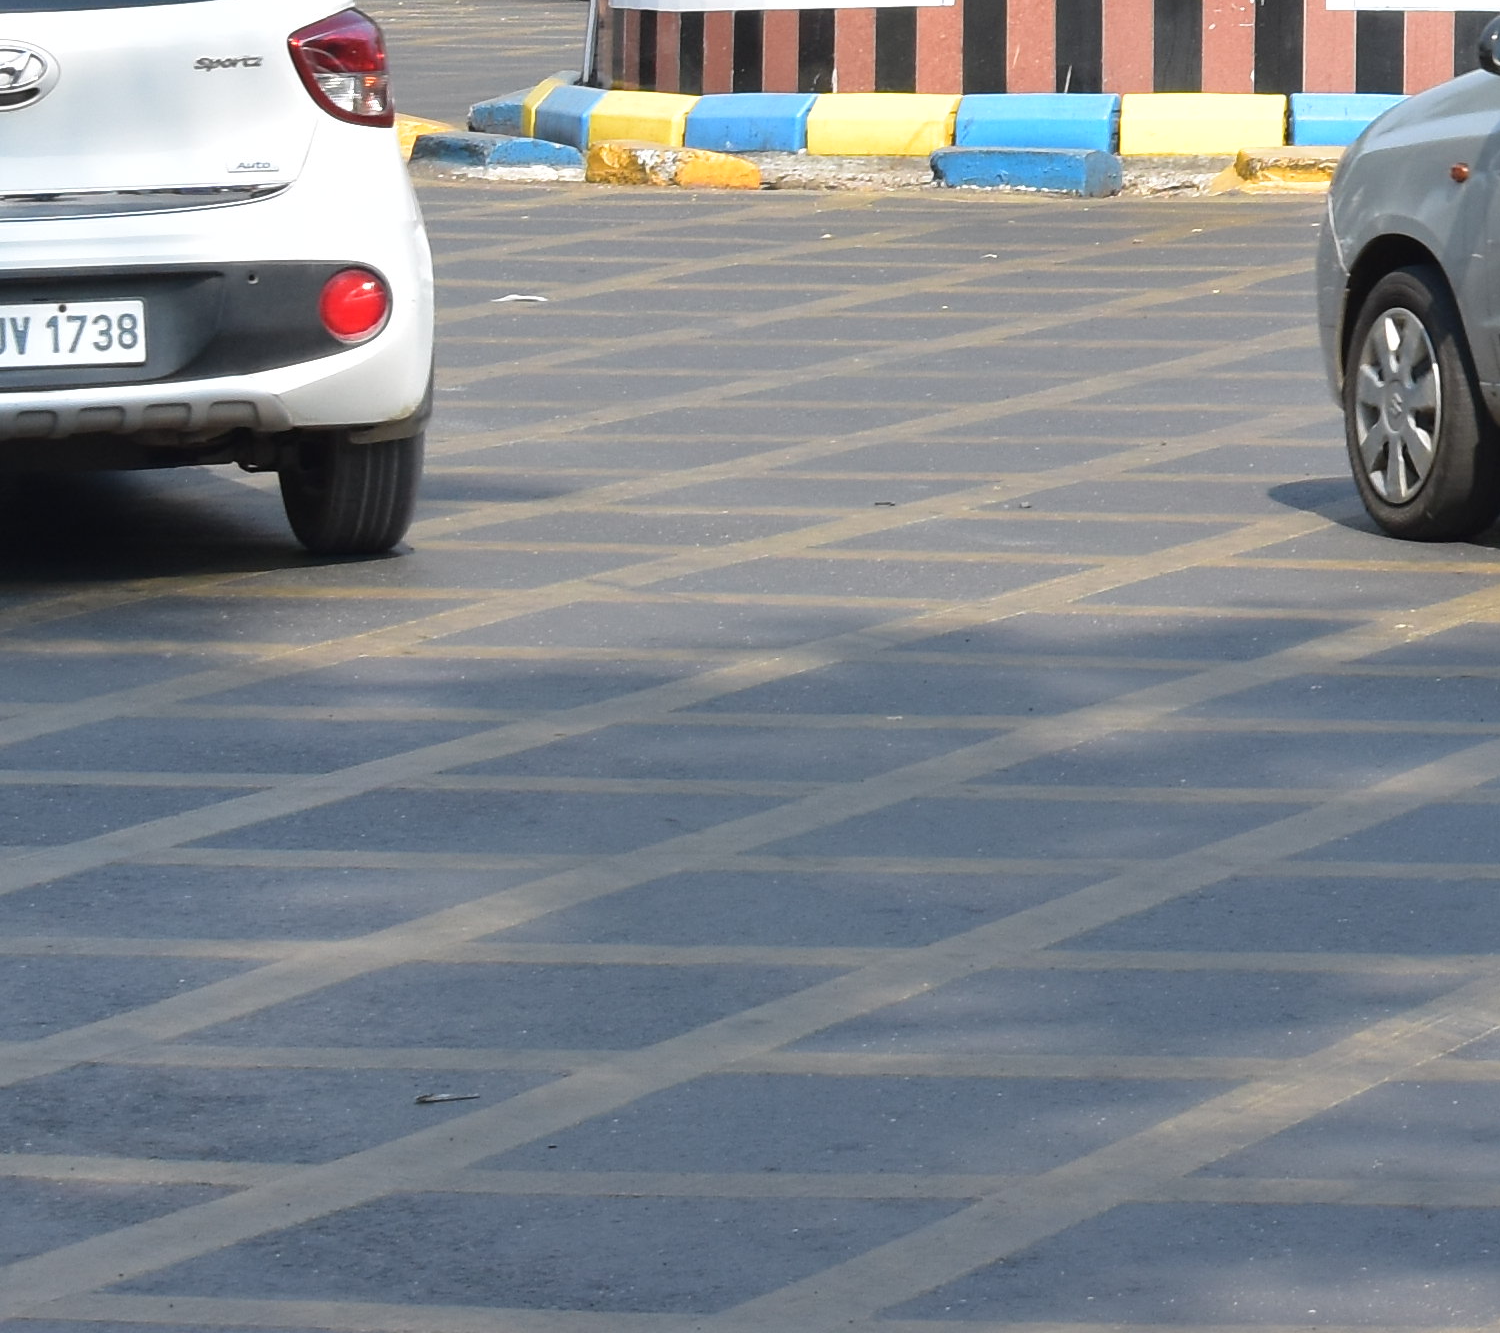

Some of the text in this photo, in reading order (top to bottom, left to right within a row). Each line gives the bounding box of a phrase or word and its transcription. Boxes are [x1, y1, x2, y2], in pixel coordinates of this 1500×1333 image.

[194, 55, 263, 72] Sportz
[237, 161, 272, 171] Auto
[45, 312, 139, 355] 1738
